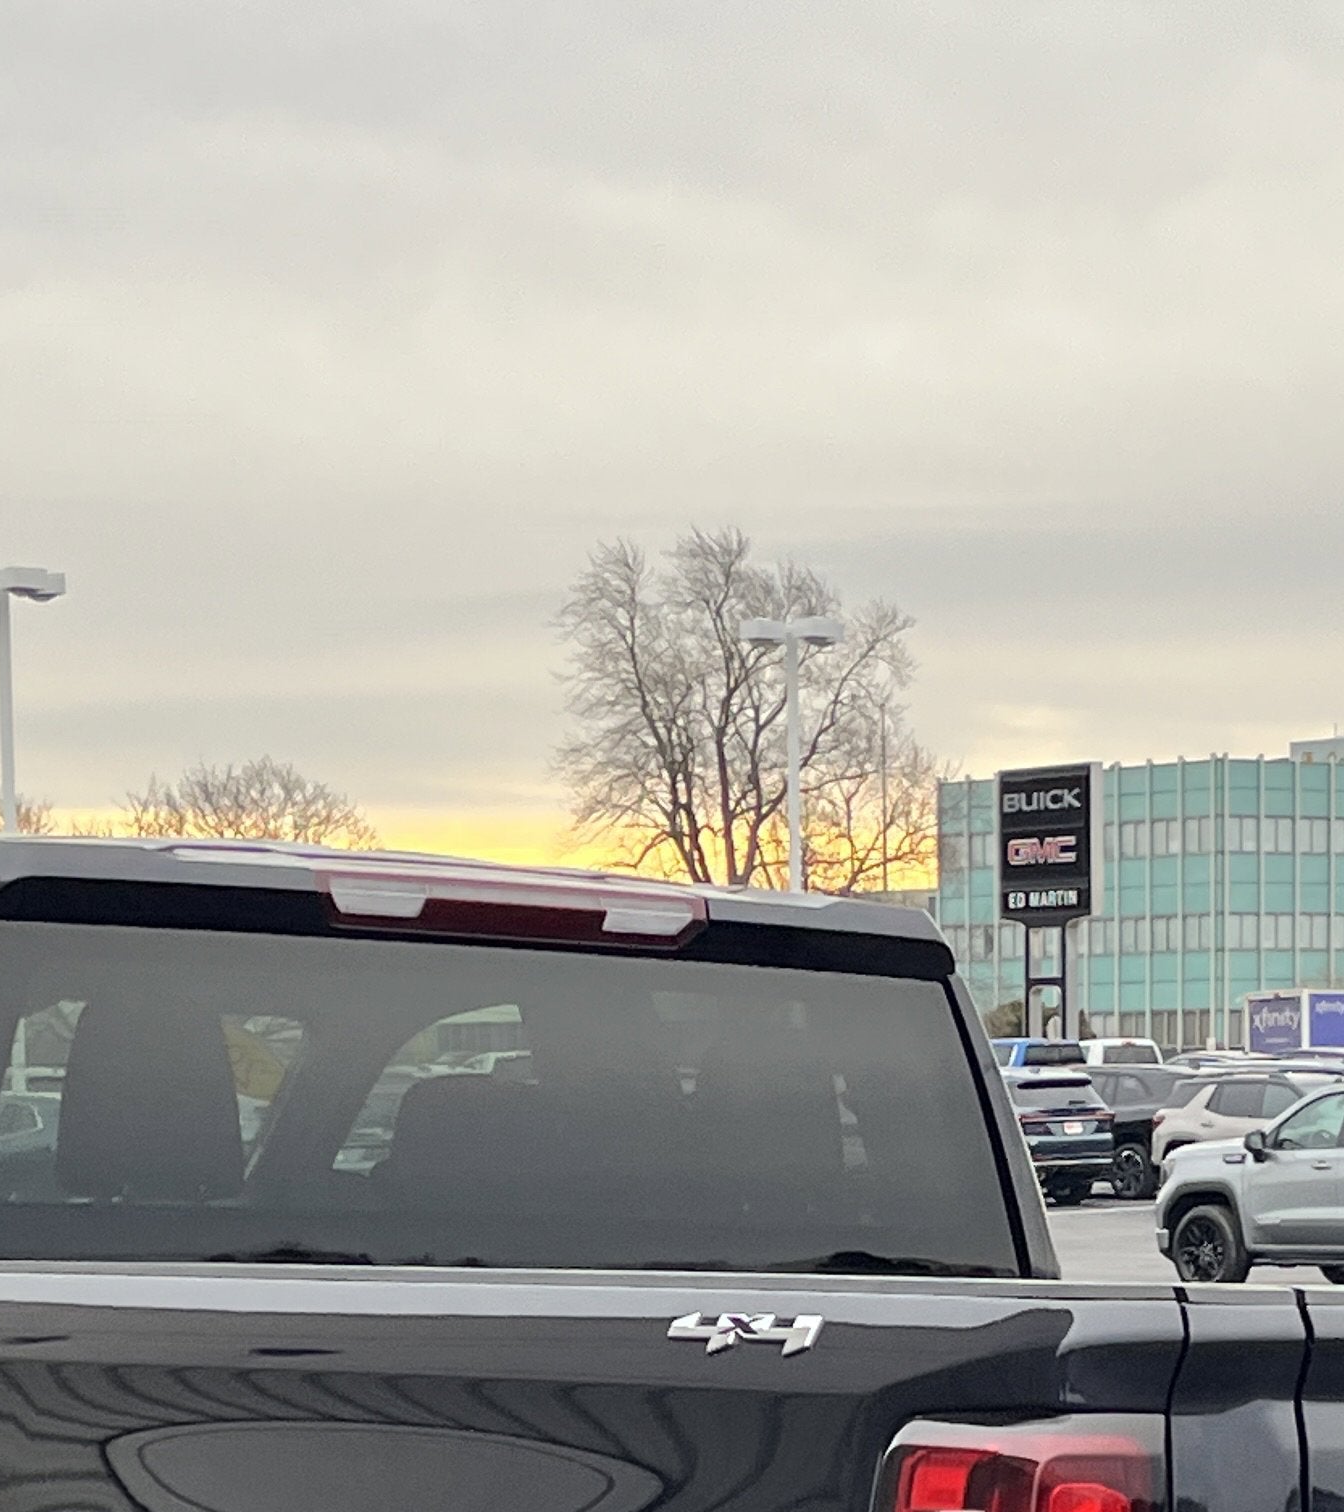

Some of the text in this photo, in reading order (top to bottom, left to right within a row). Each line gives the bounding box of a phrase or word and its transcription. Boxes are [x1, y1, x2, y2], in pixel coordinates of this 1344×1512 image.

[1003, 788, 1082, 813] BUICK
[1007, 835, 1078, 866] GMC
[1008, 889, 1078, 909] ED MARTIN
